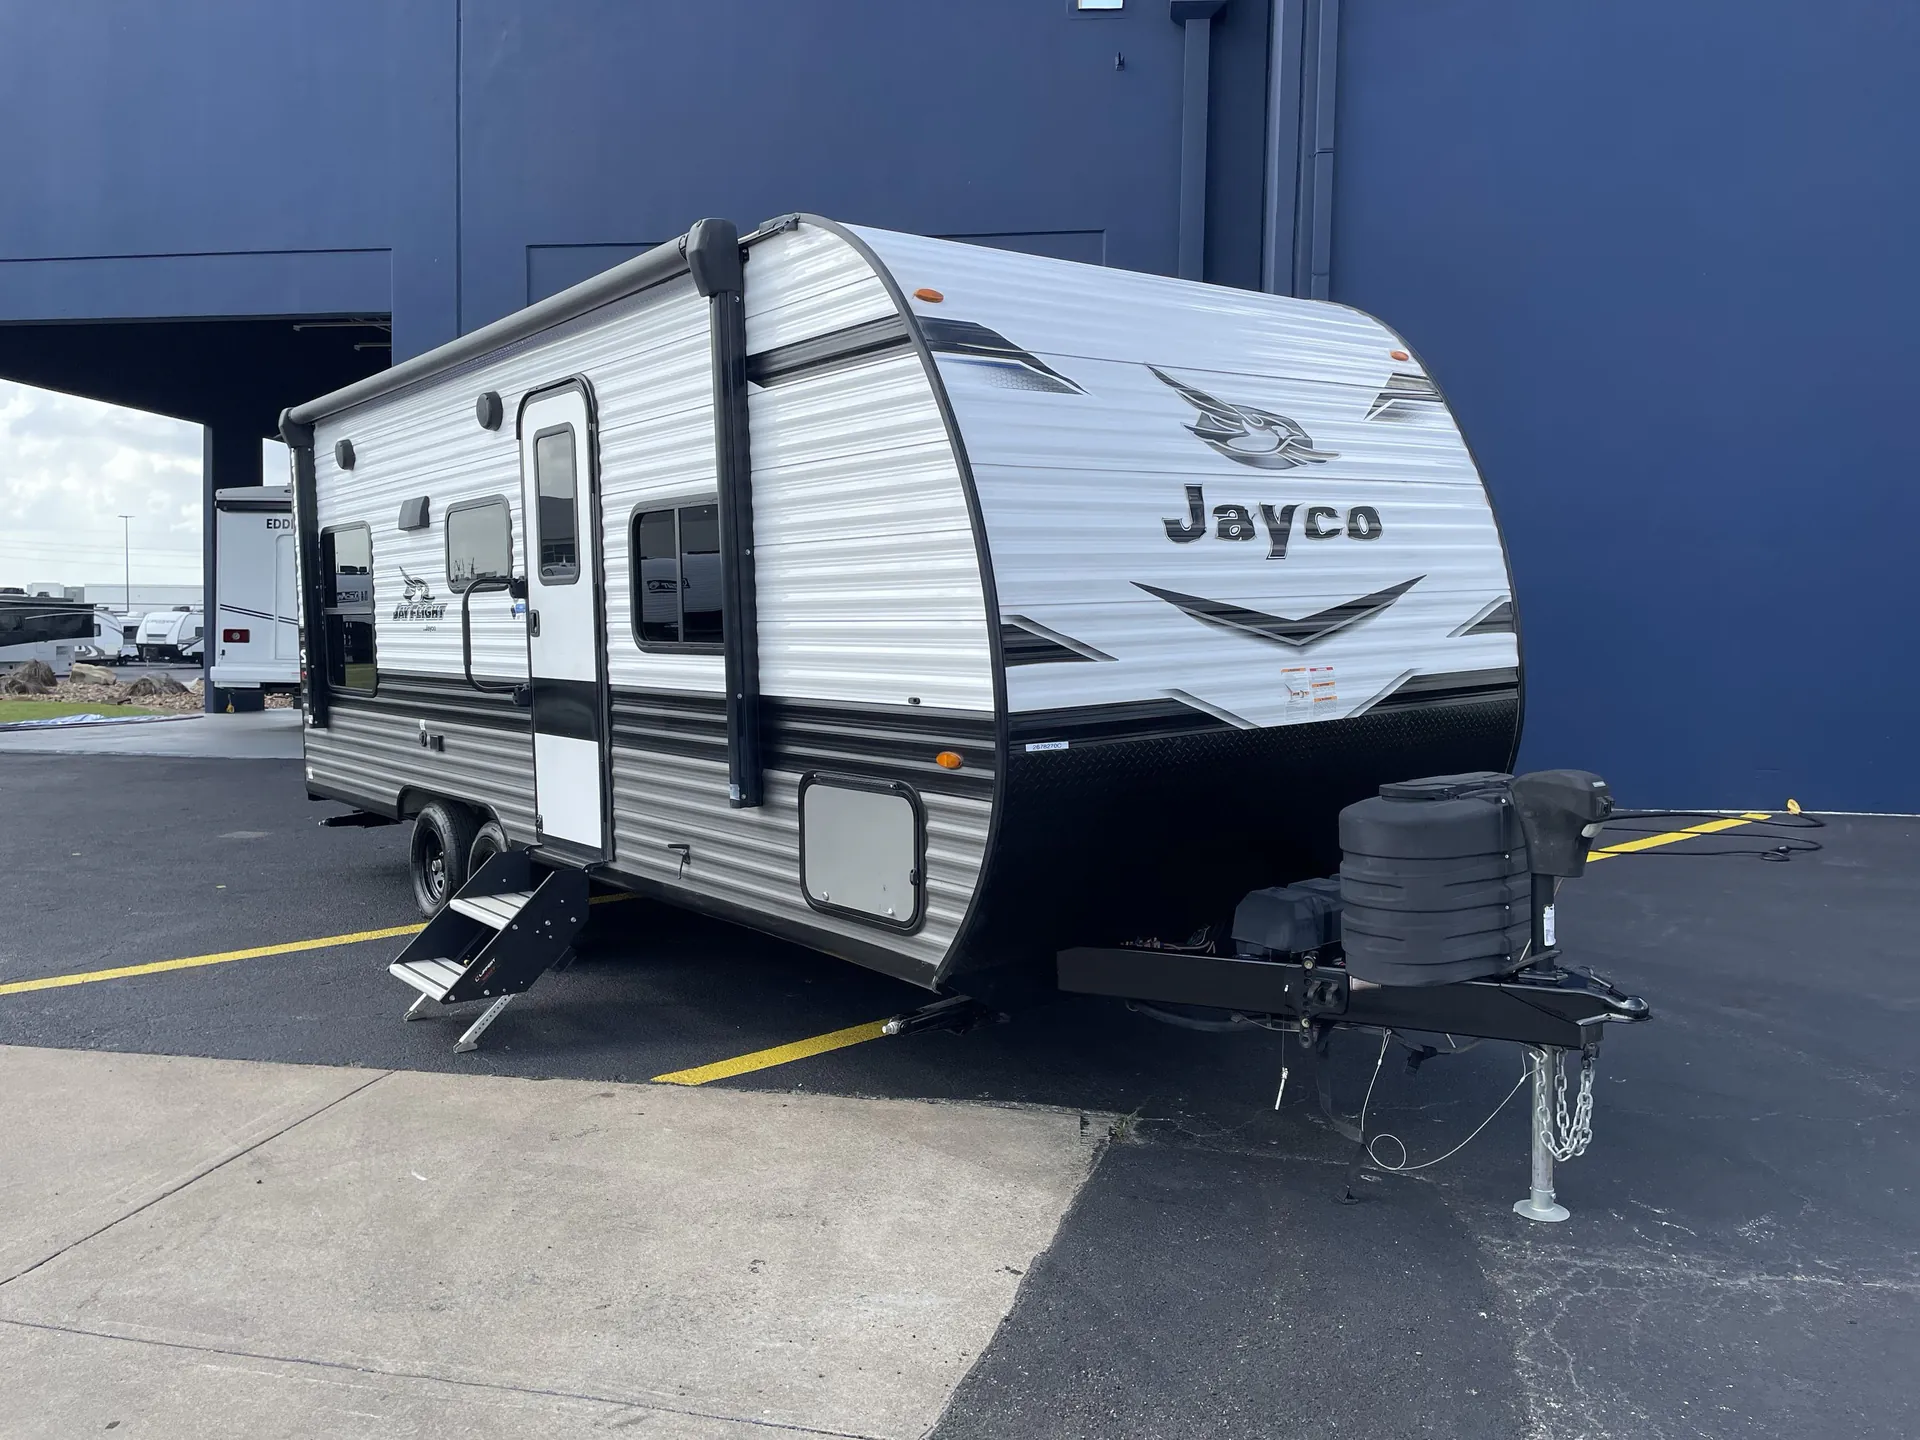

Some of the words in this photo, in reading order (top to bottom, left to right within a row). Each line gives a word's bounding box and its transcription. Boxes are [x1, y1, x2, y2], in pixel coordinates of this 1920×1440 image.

[1161, 482, 1383, 560] Jayco
[393, 603, 411, 621] JAY
[409, 602, 448, 621] FLIGHT
